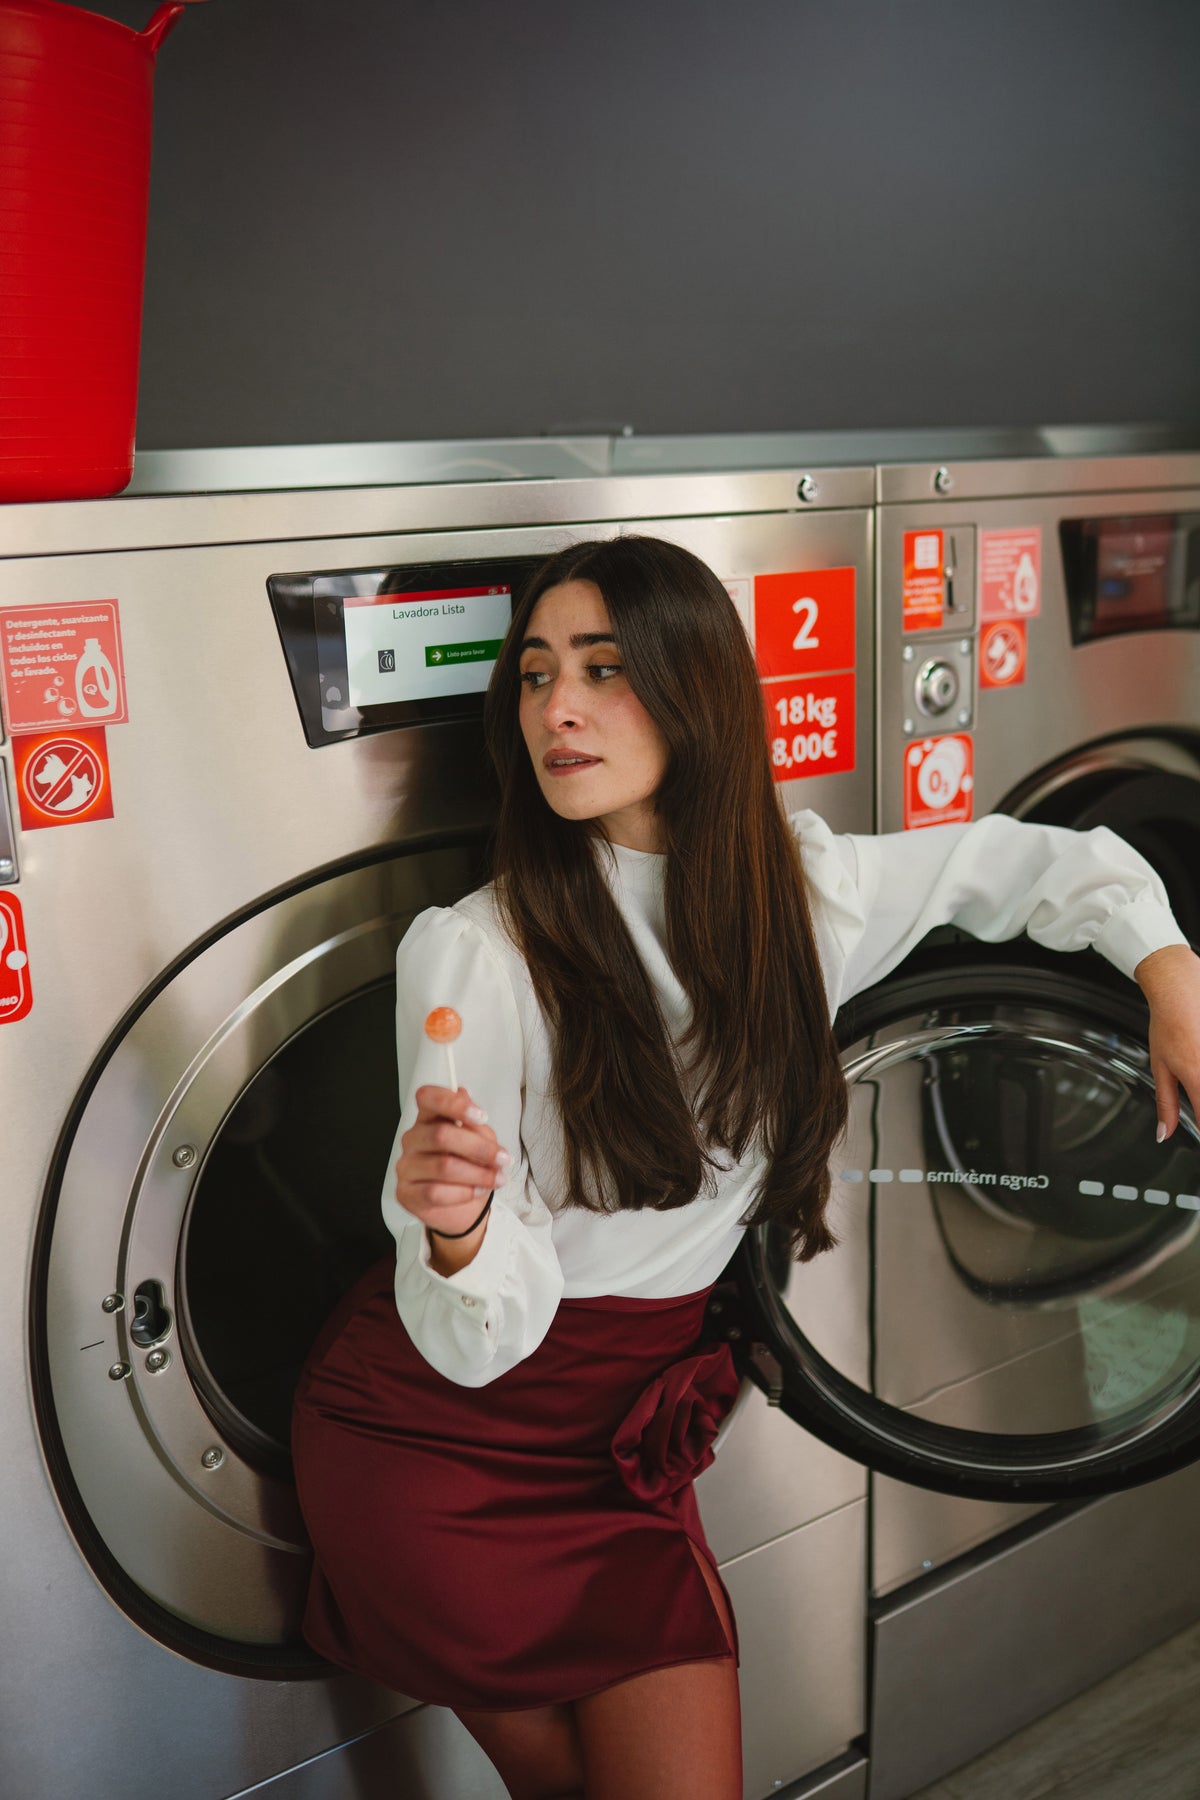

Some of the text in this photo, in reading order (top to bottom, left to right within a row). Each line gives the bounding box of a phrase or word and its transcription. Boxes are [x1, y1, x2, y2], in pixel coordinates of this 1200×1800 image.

[393, 604, 465, 620] Lavadora Lista
[6, 615, 109, 629] Detergente, suavizante
[792, 597, 819, 650] 2
[7, 629, 76, 643] y desinfectante
[8, 642, 63, 653] incluidos en
[10, 652, 77, 665] todos los ciclos
[11, 669, 23, 678] de
[775, 692, 837, 728] 18kg
[772, 729, 838, 769] 8,00€
